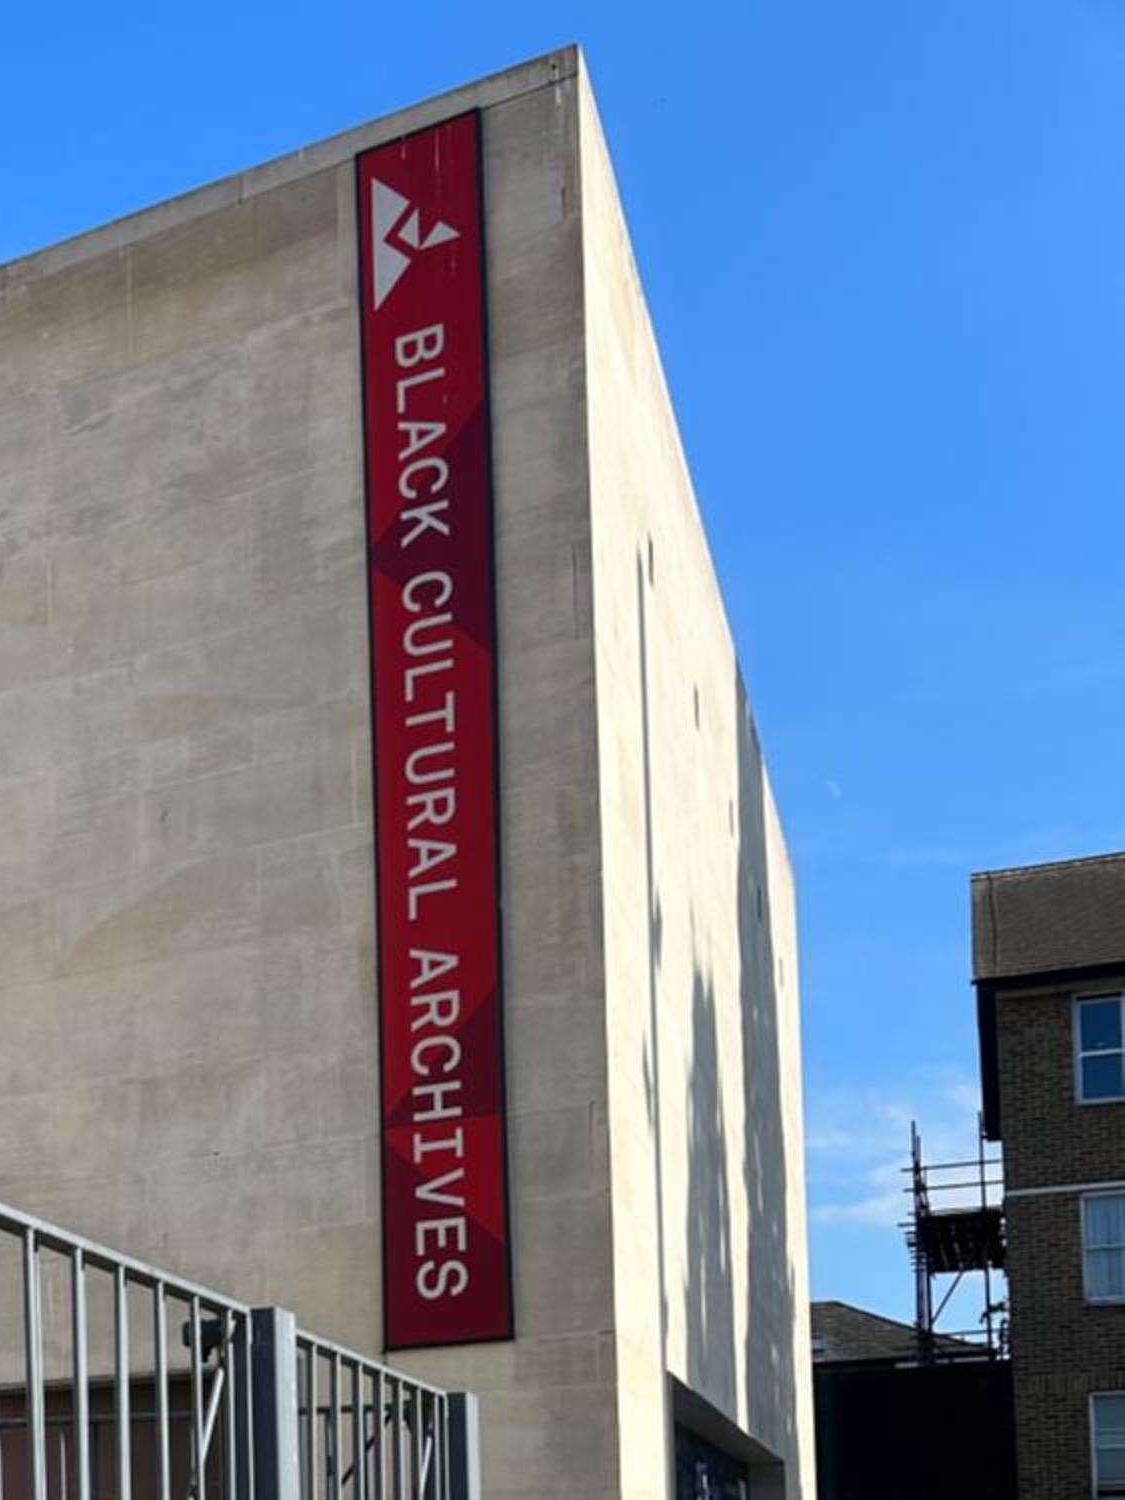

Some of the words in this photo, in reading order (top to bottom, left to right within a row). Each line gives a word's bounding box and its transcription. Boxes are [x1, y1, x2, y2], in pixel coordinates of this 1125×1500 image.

[394, 323, 450, 549] BLACK
[401, 569, 458, 921] CULTURAL
[408, 947, 469, 1301] ARCHIVES
